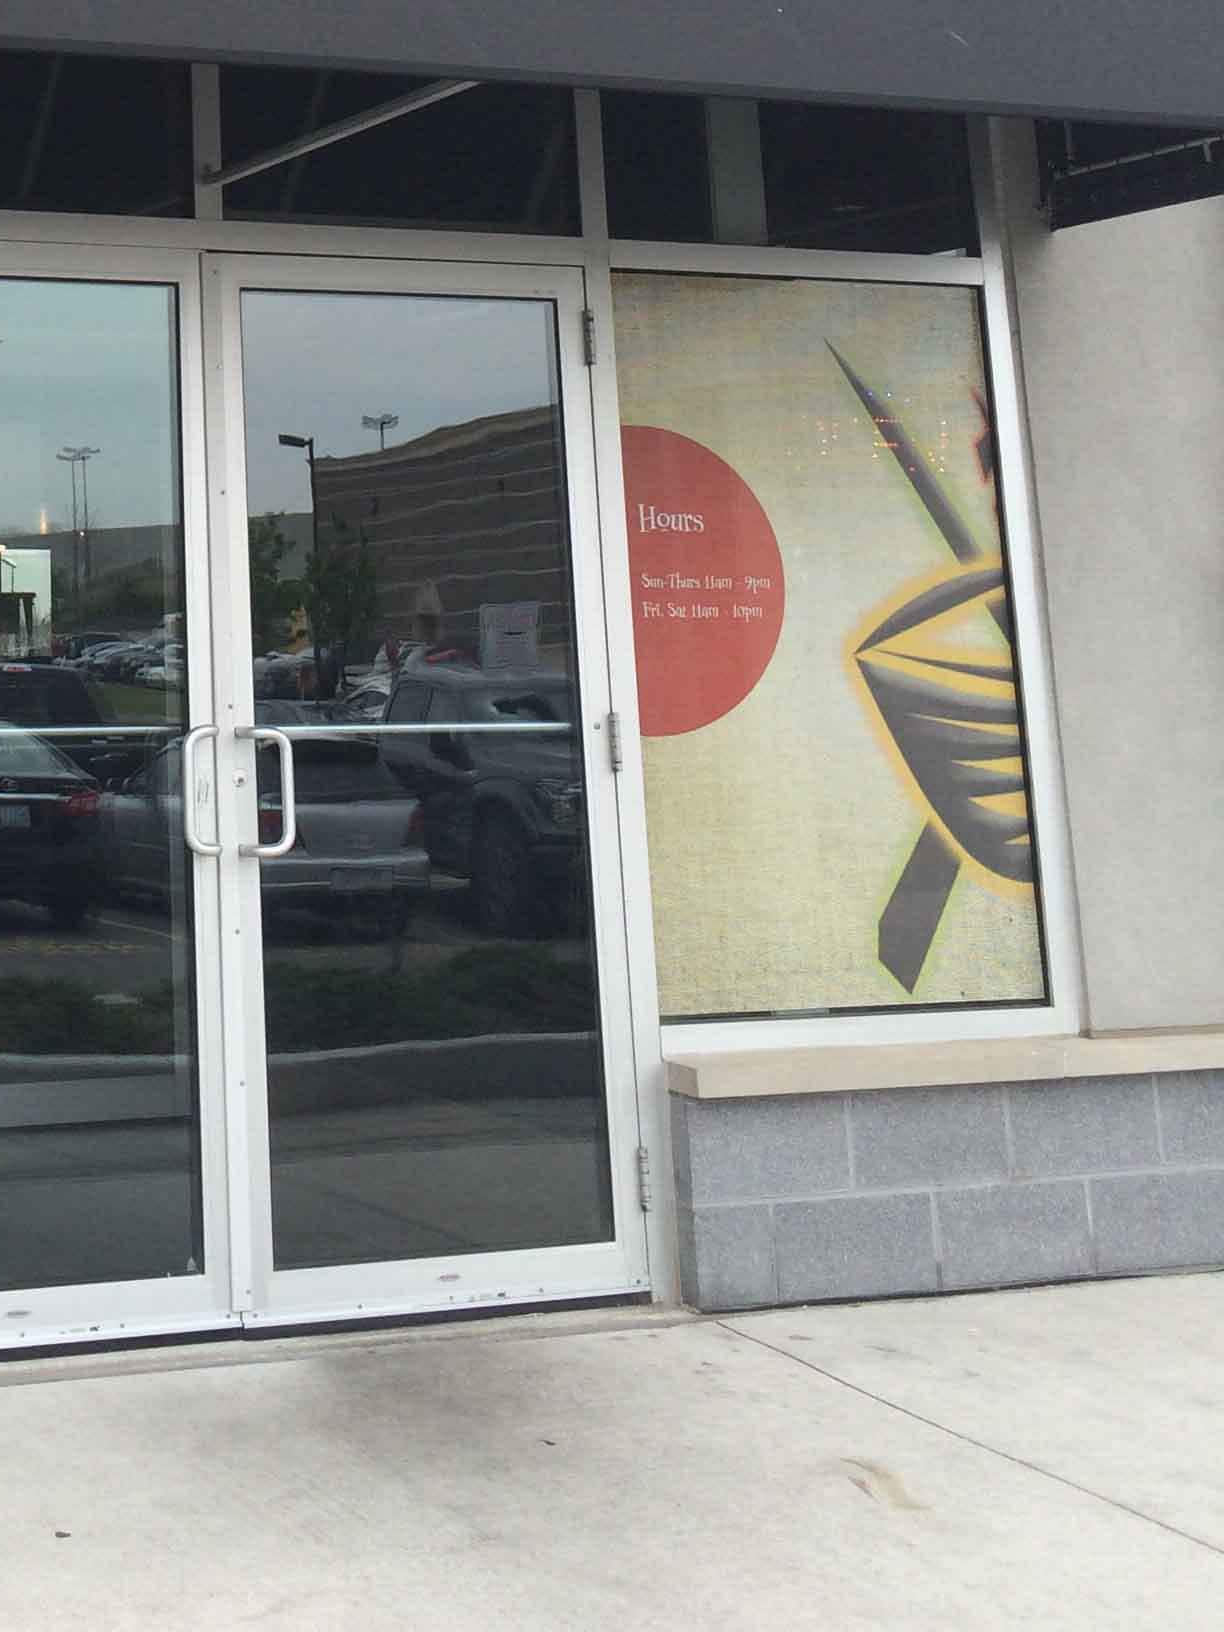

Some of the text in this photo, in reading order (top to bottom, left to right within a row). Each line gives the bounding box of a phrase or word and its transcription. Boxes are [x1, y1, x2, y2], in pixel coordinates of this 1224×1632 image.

[638, 503, 705, 534] Hours
[705, 574, 733, 589] 11am
[744, 575, 771, 594] 9pm
[667, 602, 687, 618] Sat
[691, 603, 720, 618] 11am
